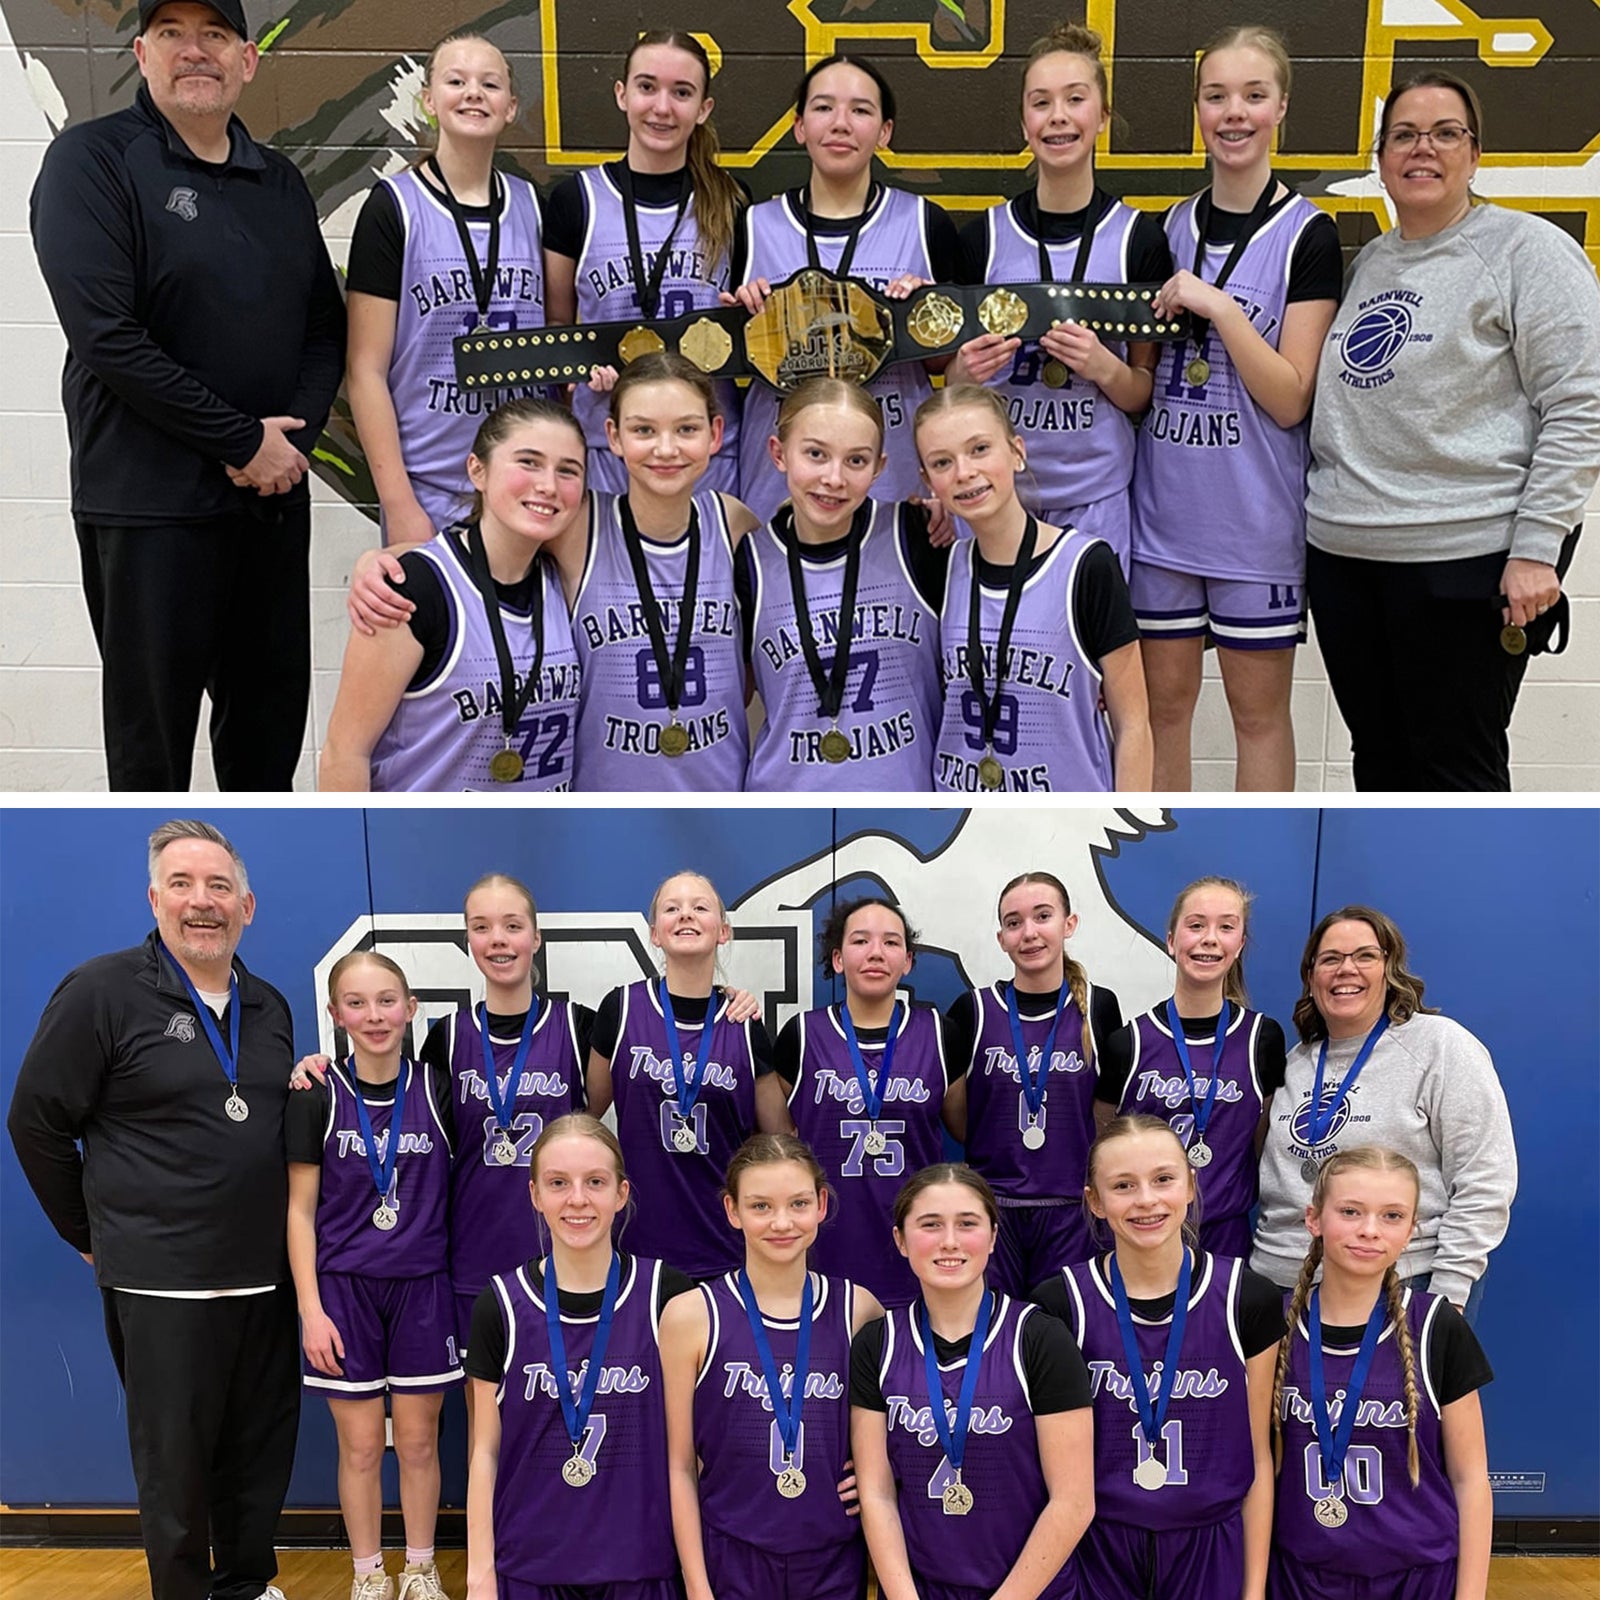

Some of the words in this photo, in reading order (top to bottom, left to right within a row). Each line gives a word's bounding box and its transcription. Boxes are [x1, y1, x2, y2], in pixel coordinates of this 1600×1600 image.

[410, 266, 543, 318] BARWEL
[588, 250, 730, 300] BAWEL
[1358, 289, 1423, 311] BARNWELL
[1339, 368, 1395, 389] ATHLETICS
[1002, 396, 1095, 432] OJANS
[1151, 407, 1241, 447] OJANS
[581, 599, 734, 650] BARNEL
[760, 604, 922, 671] BANWELL
[636, 646, 707, 710] 88
[605, 708, 730, 755] TROANS
[789, 711, 915, 763] TRJANS
[960, 690, 1019, 756] 99
[938, 752, 1052, 792] TRONS
[660, 1100, 709, 1155] 61
[839, 1120, 905, 1177] 75
[446, 1336, 459, 1366] 1
[1281, 1387, 1410, 1437] Trjns
[580, 1414, 607, 1476] 7
[1132, 1420, 1188, 1485] 11
[1304, 1441, 1383, 1505] 00
